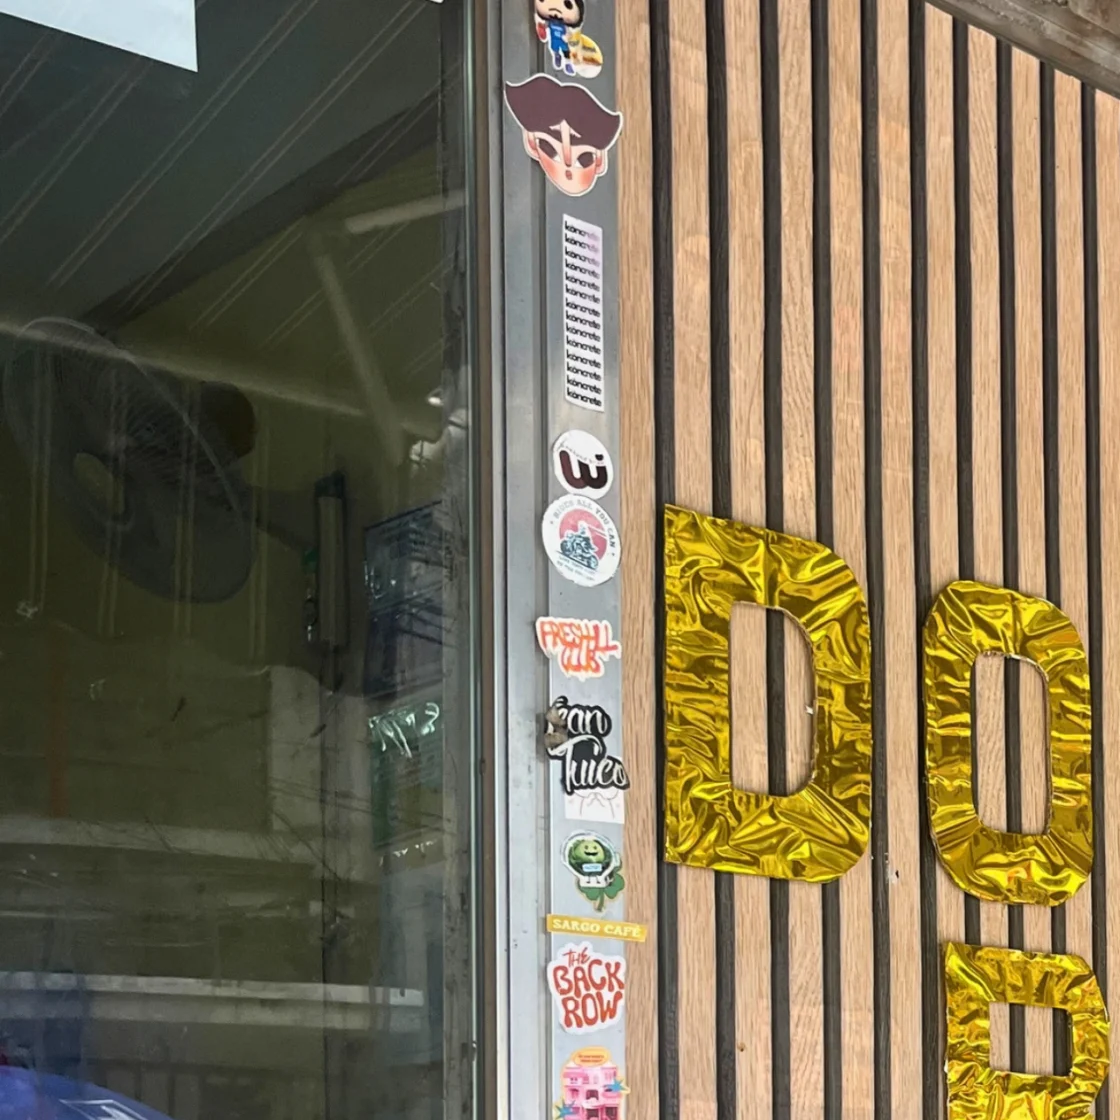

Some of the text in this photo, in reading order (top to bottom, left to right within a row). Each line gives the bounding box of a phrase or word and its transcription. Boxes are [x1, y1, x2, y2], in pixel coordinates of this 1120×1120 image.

[552, 918, 642, 938] SARGO CAFÉ
[562, 947, 590, 967] THE
[553, 959, 625, 998] BACK
[562, 991, 623, 1028] ROW
